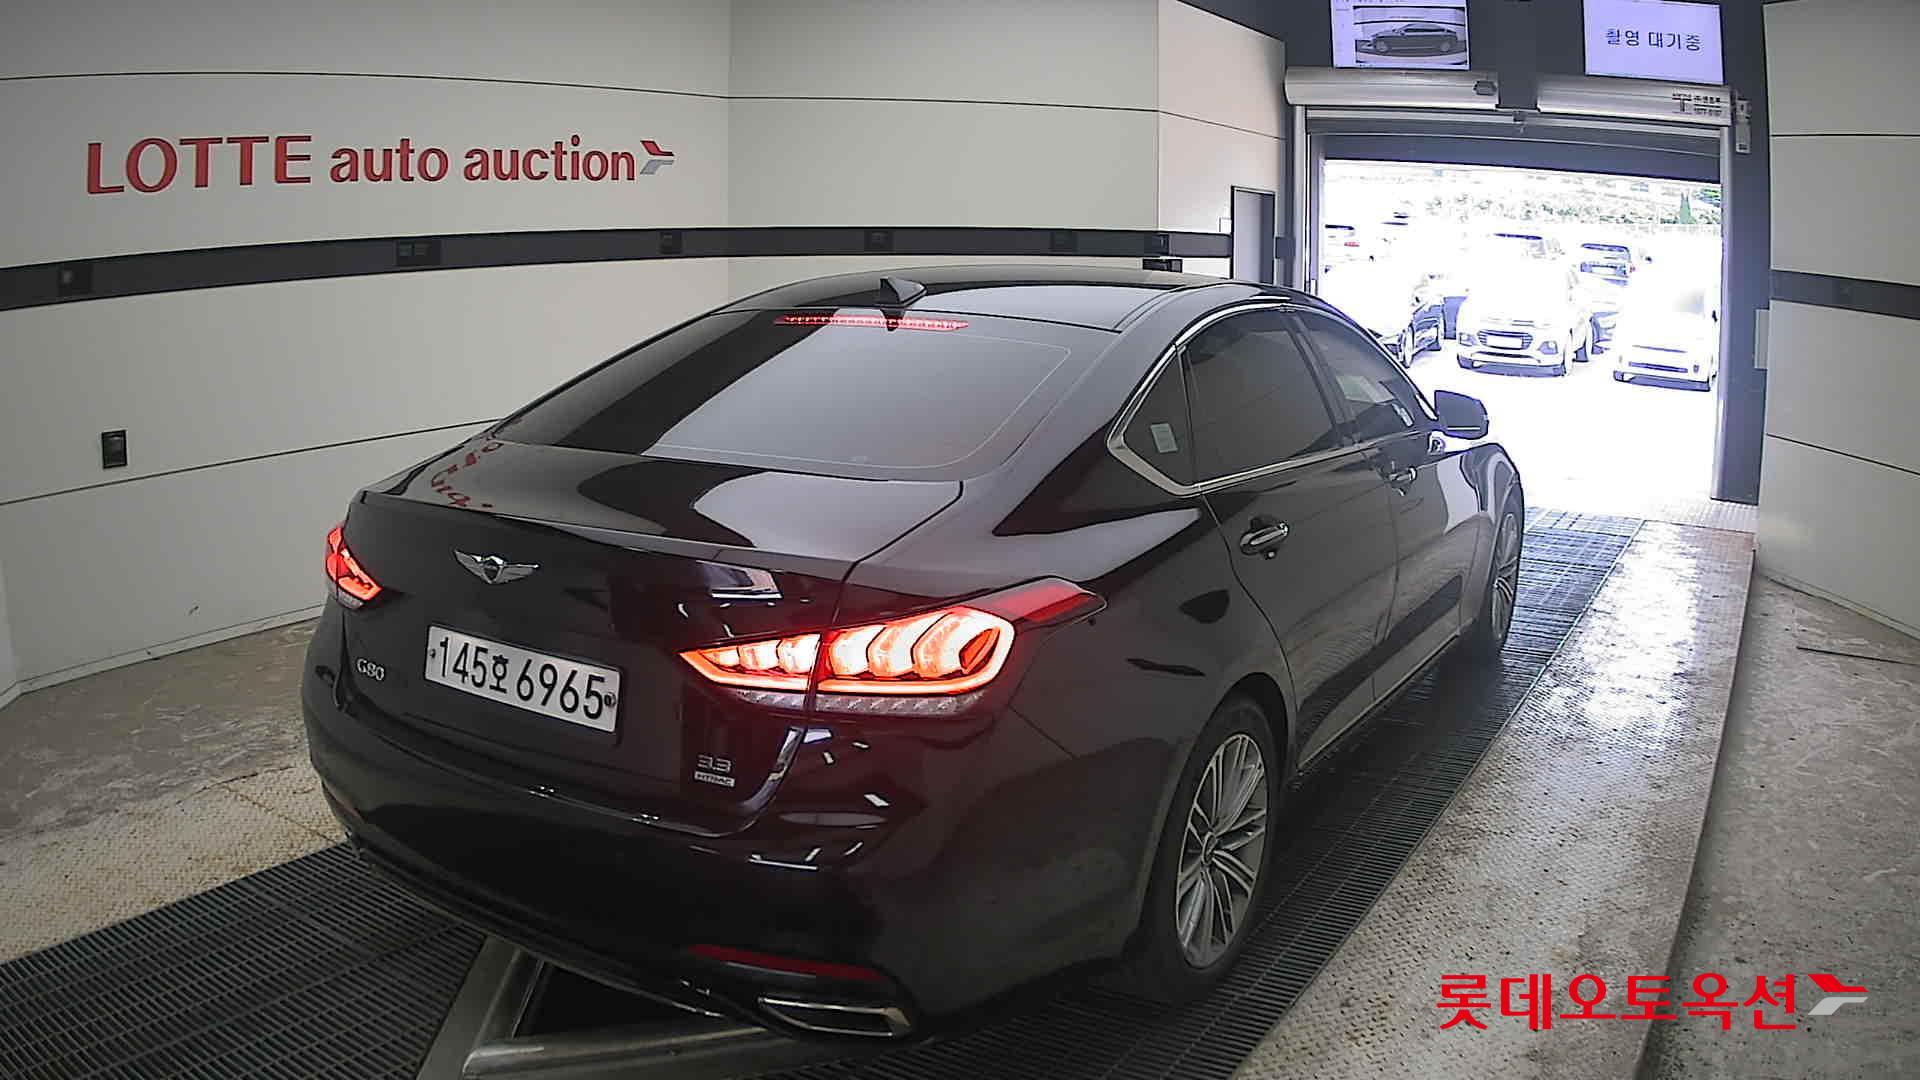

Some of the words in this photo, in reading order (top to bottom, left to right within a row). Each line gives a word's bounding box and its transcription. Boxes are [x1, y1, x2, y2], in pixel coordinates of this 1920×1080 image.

[1647, 31, 1701, 52] 대기중
[87, 135, 312, 194] LOTTE
[330, 138, 450, 183] auto
[463, 134, 636, 182] auction
[356, 656, 386, 681] G80
